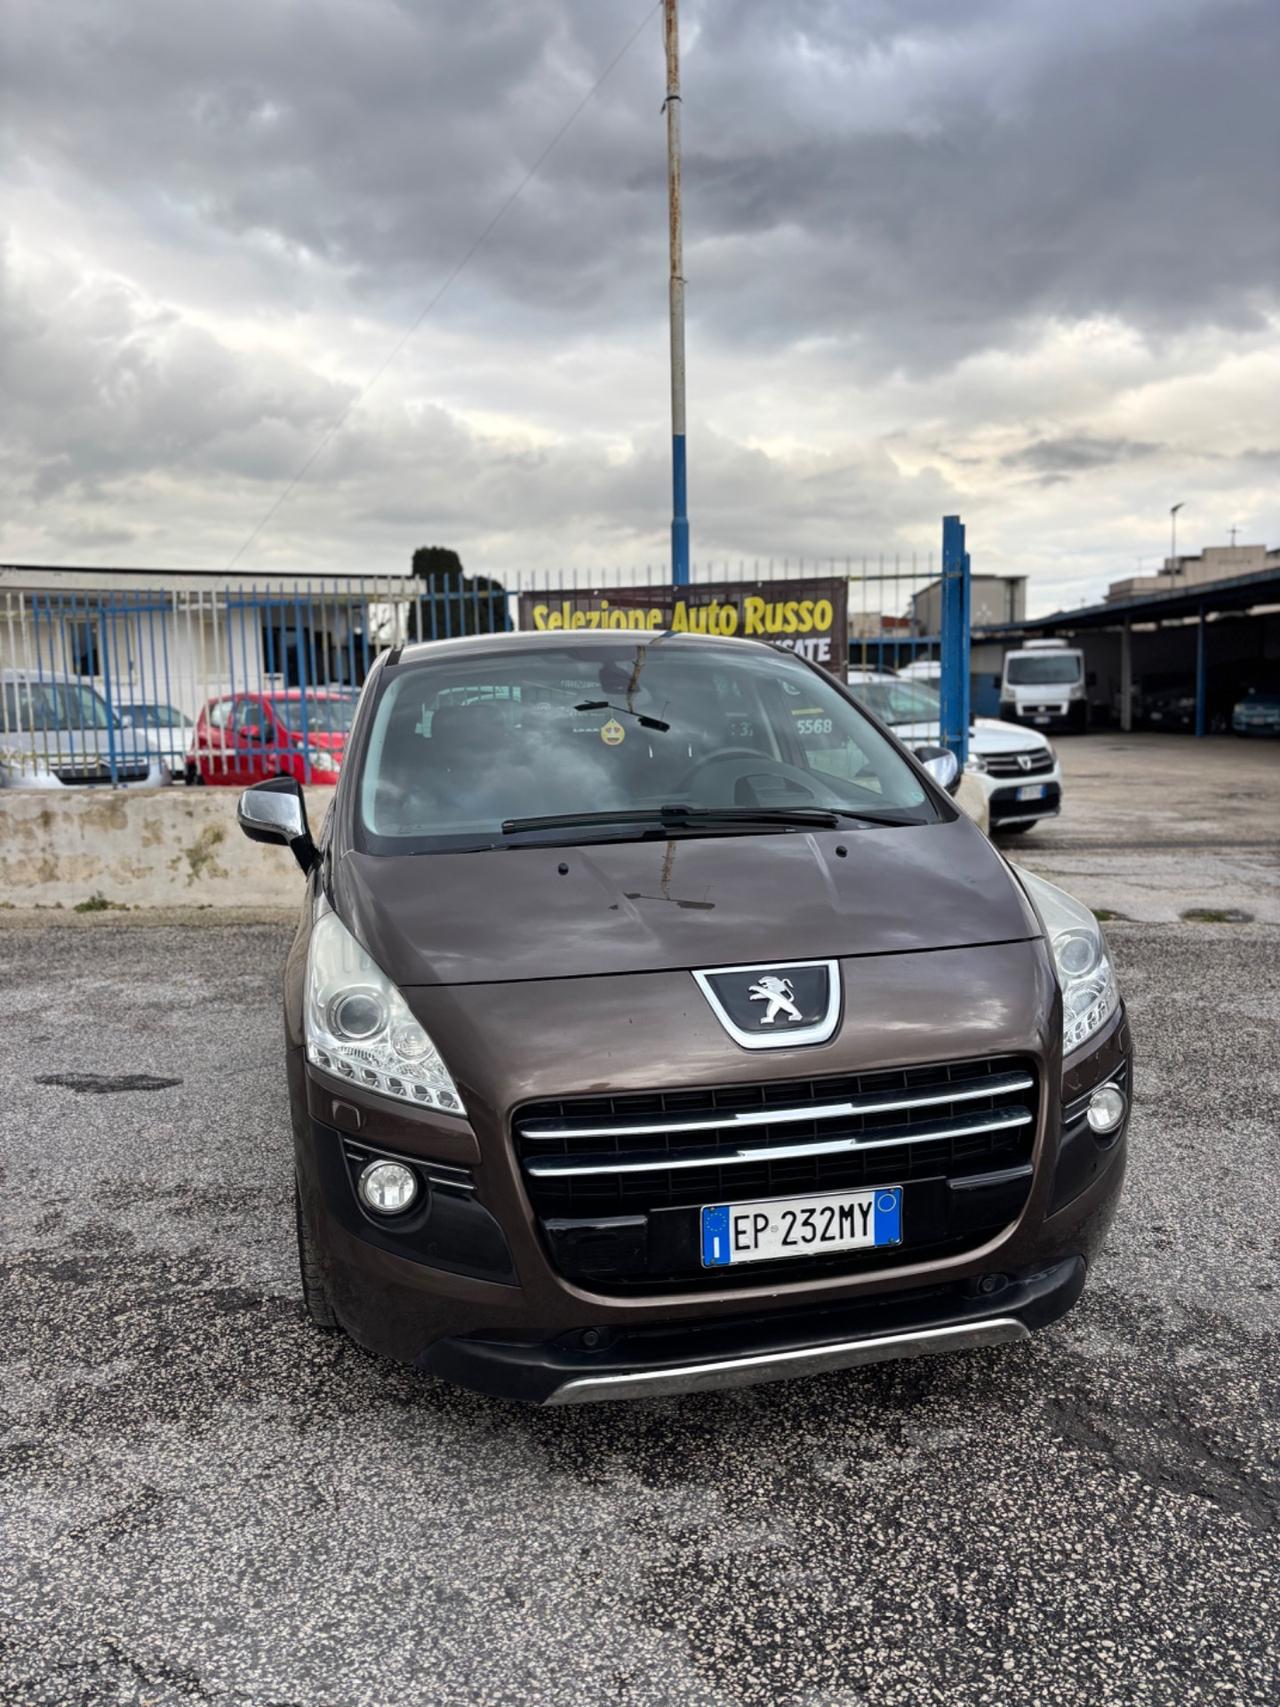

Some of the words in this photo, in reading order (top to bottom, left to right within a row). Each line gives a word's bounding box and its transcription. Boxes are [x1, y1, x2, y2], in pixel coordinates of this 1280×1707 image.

[533, 600, 663, 630] Selezione
[672, 598, 739, 636] Auto
[744, 596, 833, 635] Russo
[796, 718, 833, 735] 5568
[734, 1213, 769, 1251] EP
[781, 1201, 873, 1247] 232MY
